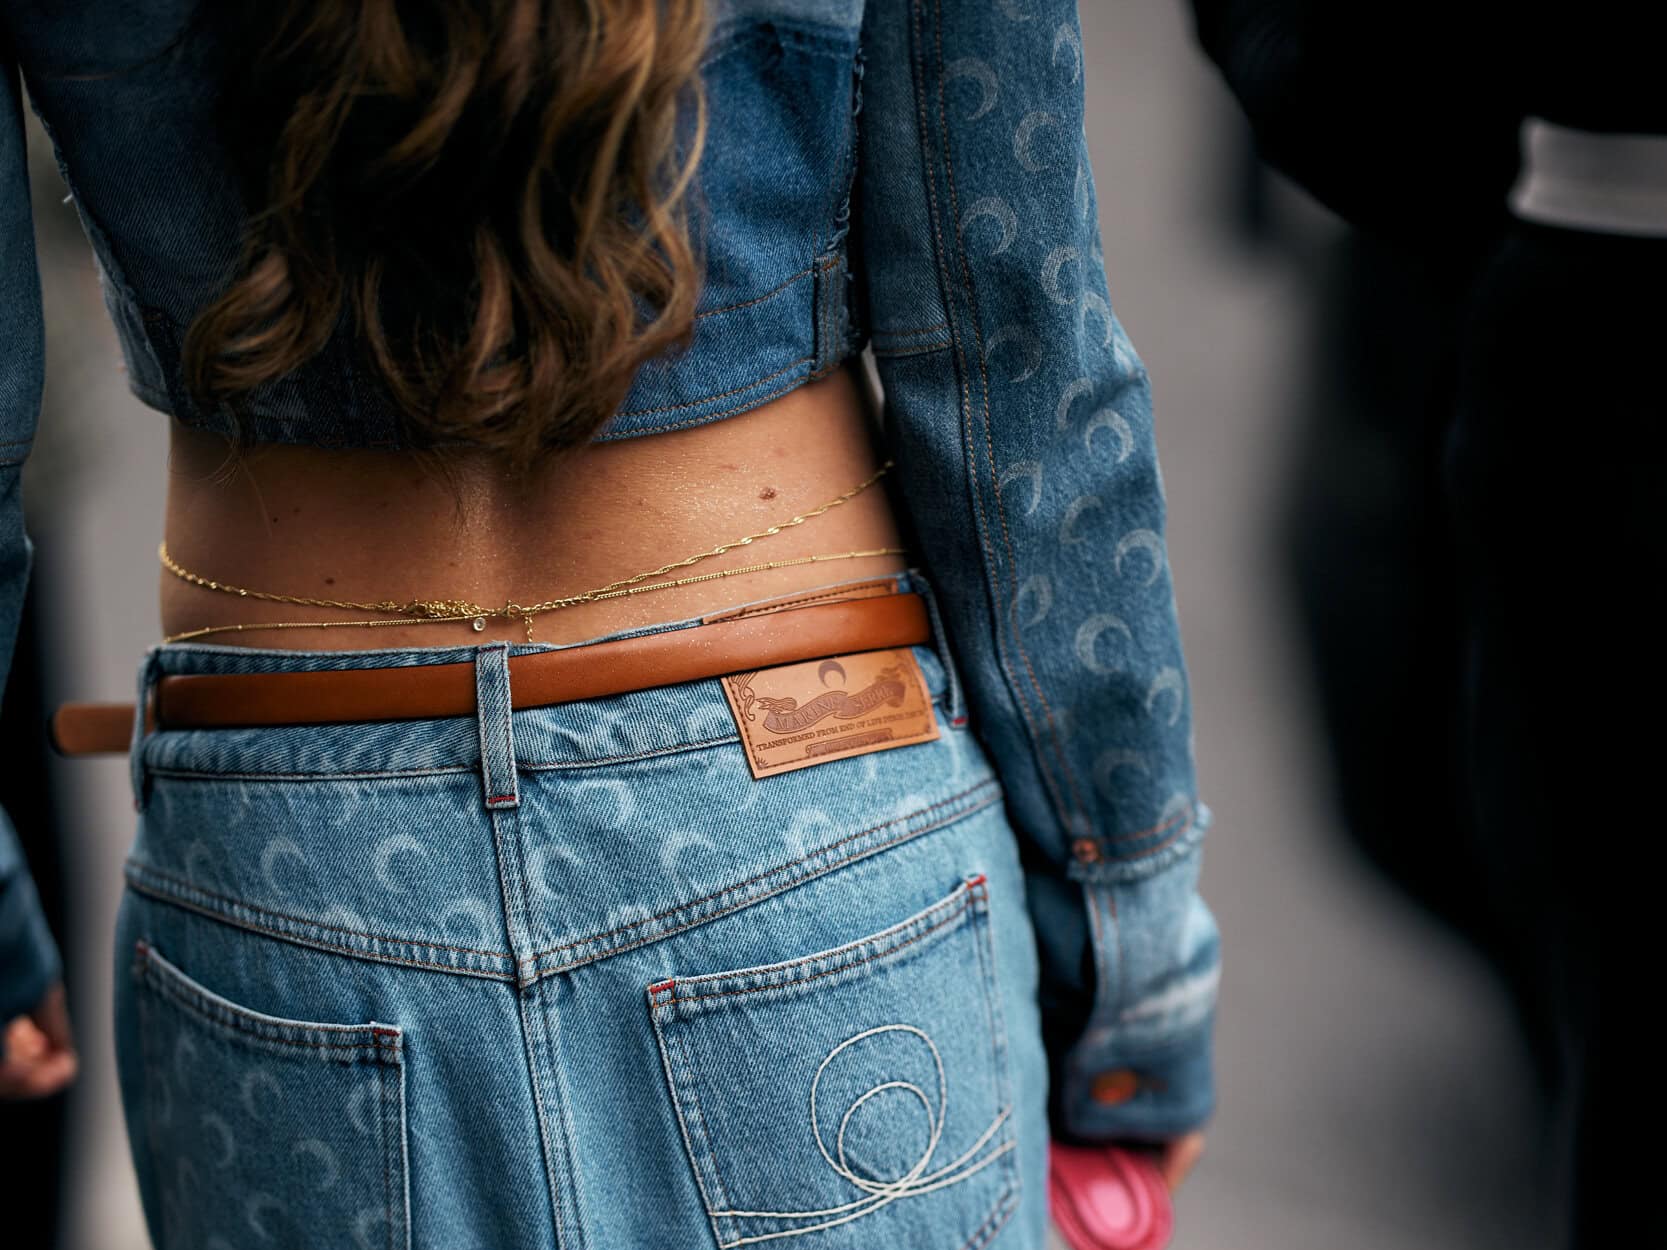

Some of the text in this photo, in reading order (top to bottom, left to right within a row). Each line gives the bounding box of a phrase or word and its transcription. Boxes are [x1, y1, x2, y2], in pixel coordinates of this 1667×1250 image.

[756, 732, 816, 751] TRANSFORMED
[816, 726, 839, 737] FROM
[840, 722, 855, 732] END
[856, 719, 865, 729] OF
